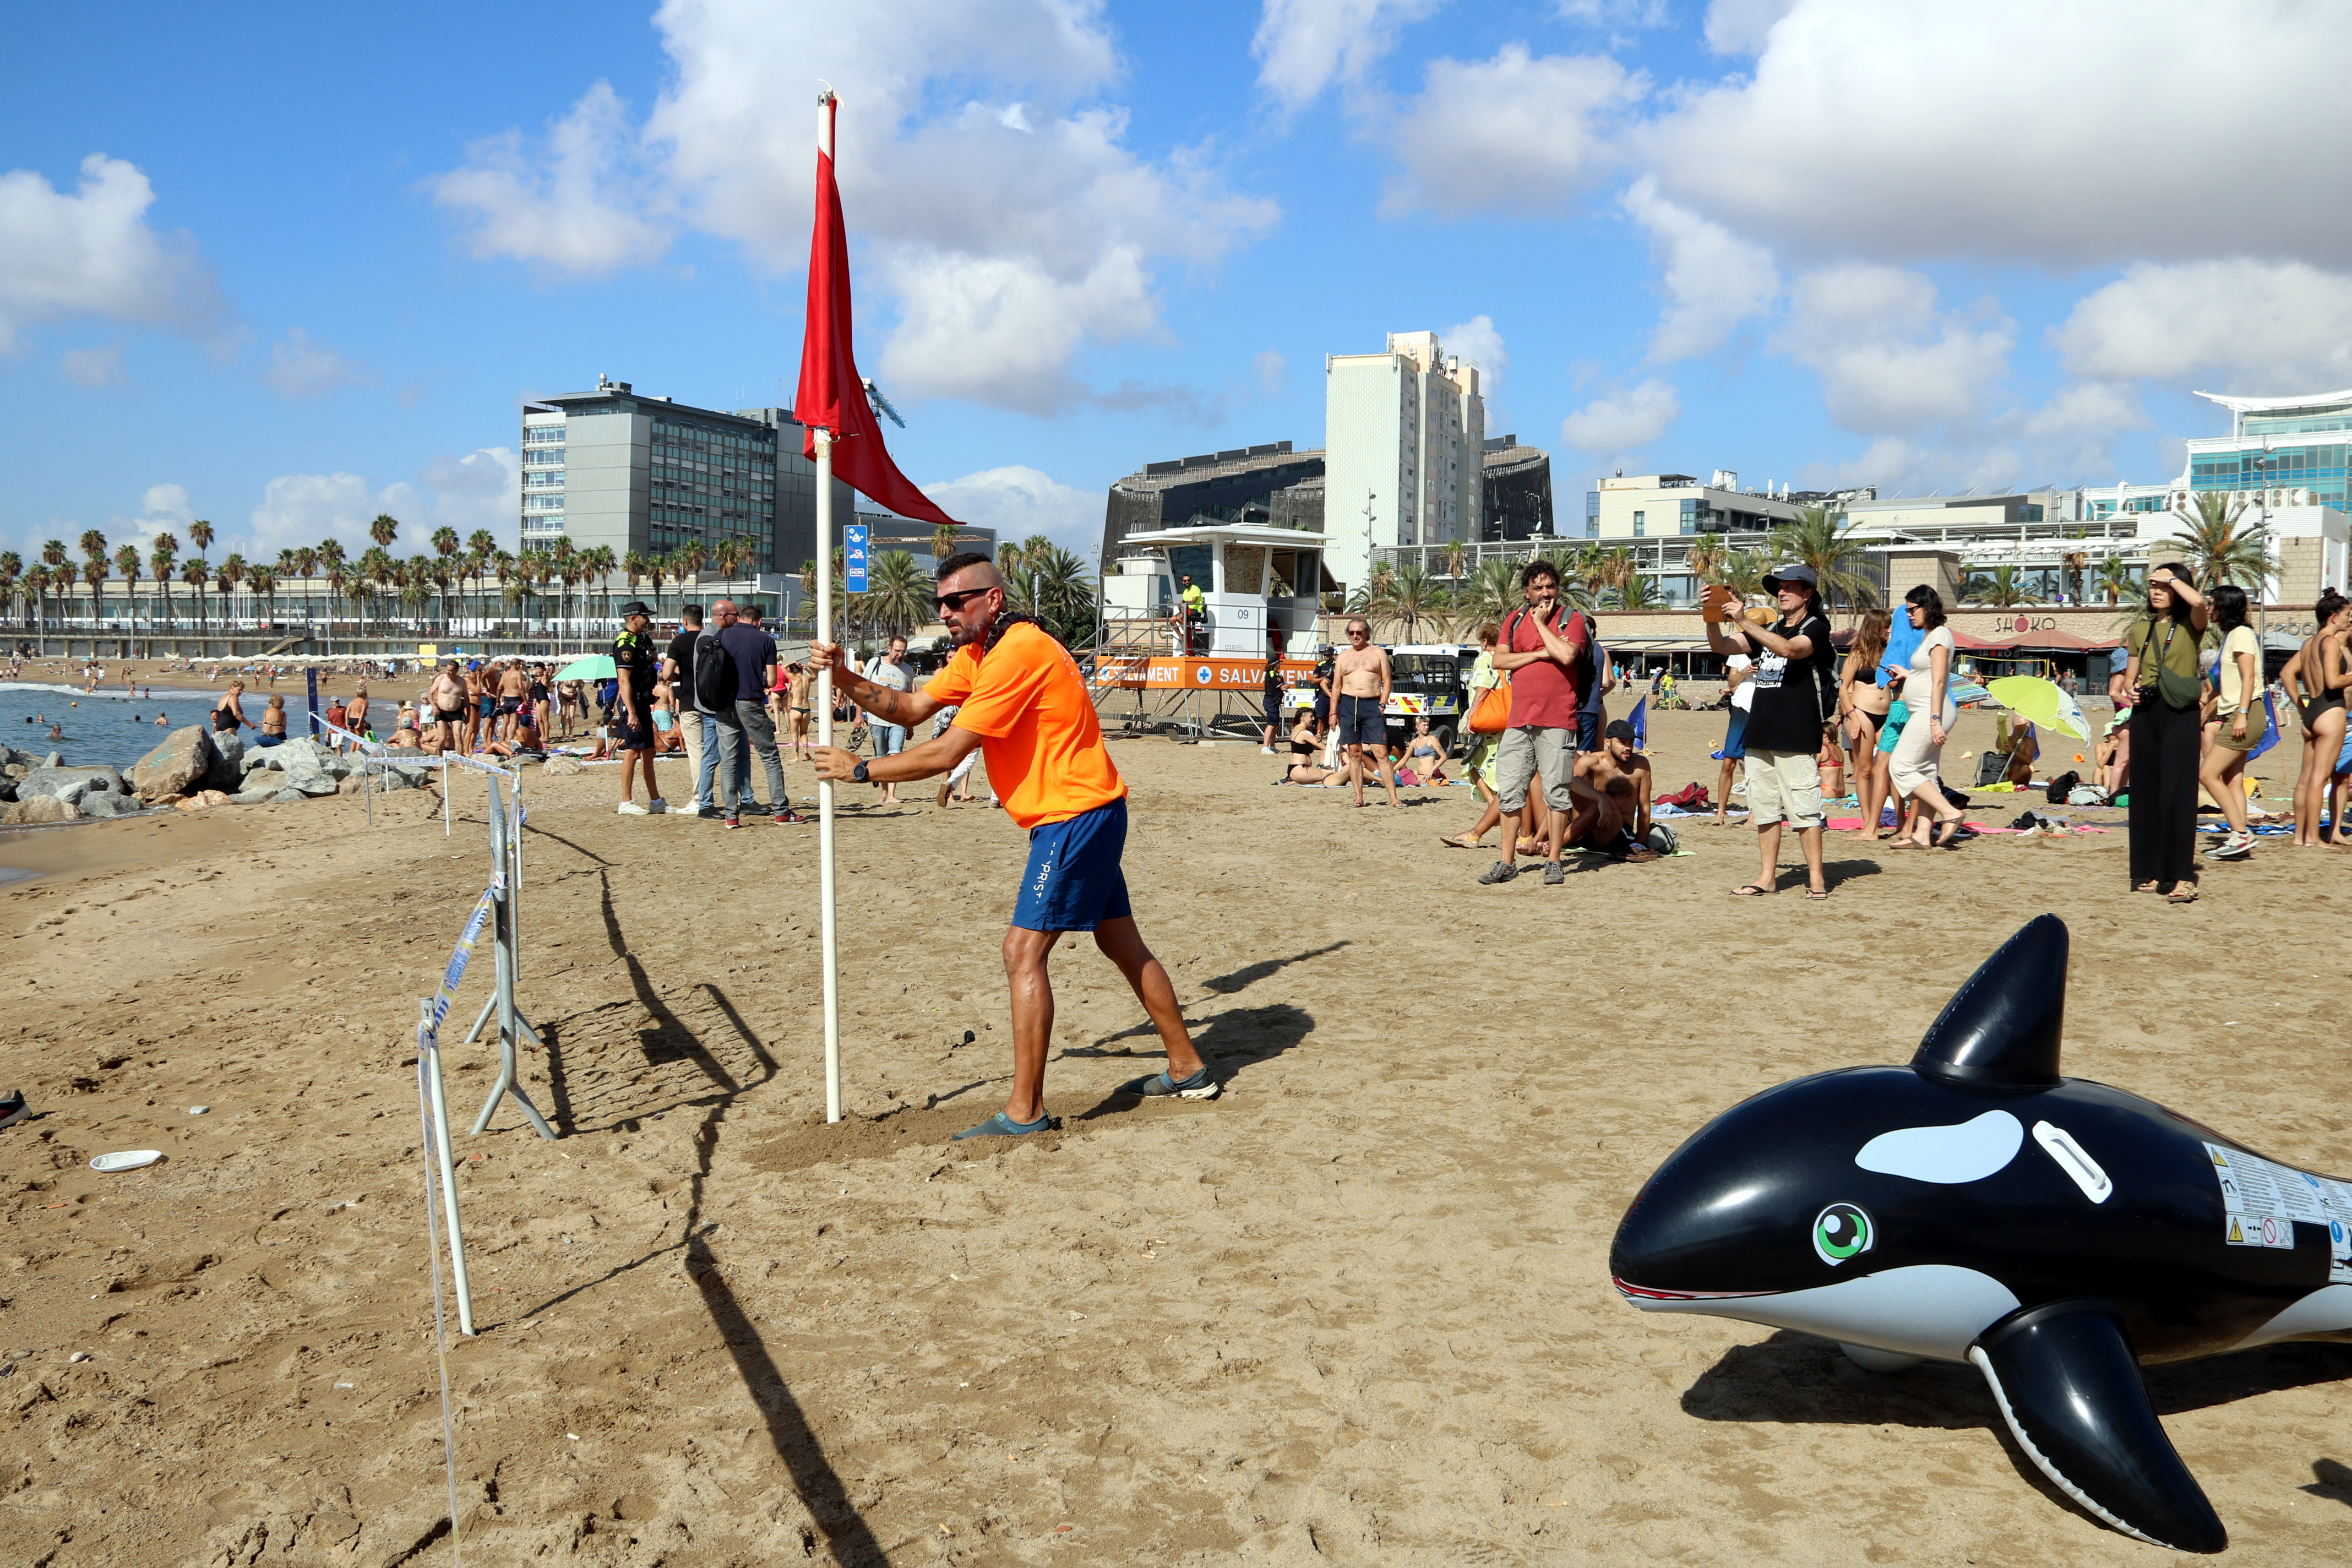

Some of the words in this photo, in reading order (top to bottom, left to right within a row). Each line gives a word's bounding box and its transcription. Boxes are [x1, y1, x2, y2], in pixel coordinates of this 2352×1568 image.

[1238, 609, 1249, 619] 09
[2166, 627, 2175, 641] SONY
[1113, 666, 1179, 682] SALVAMENT
